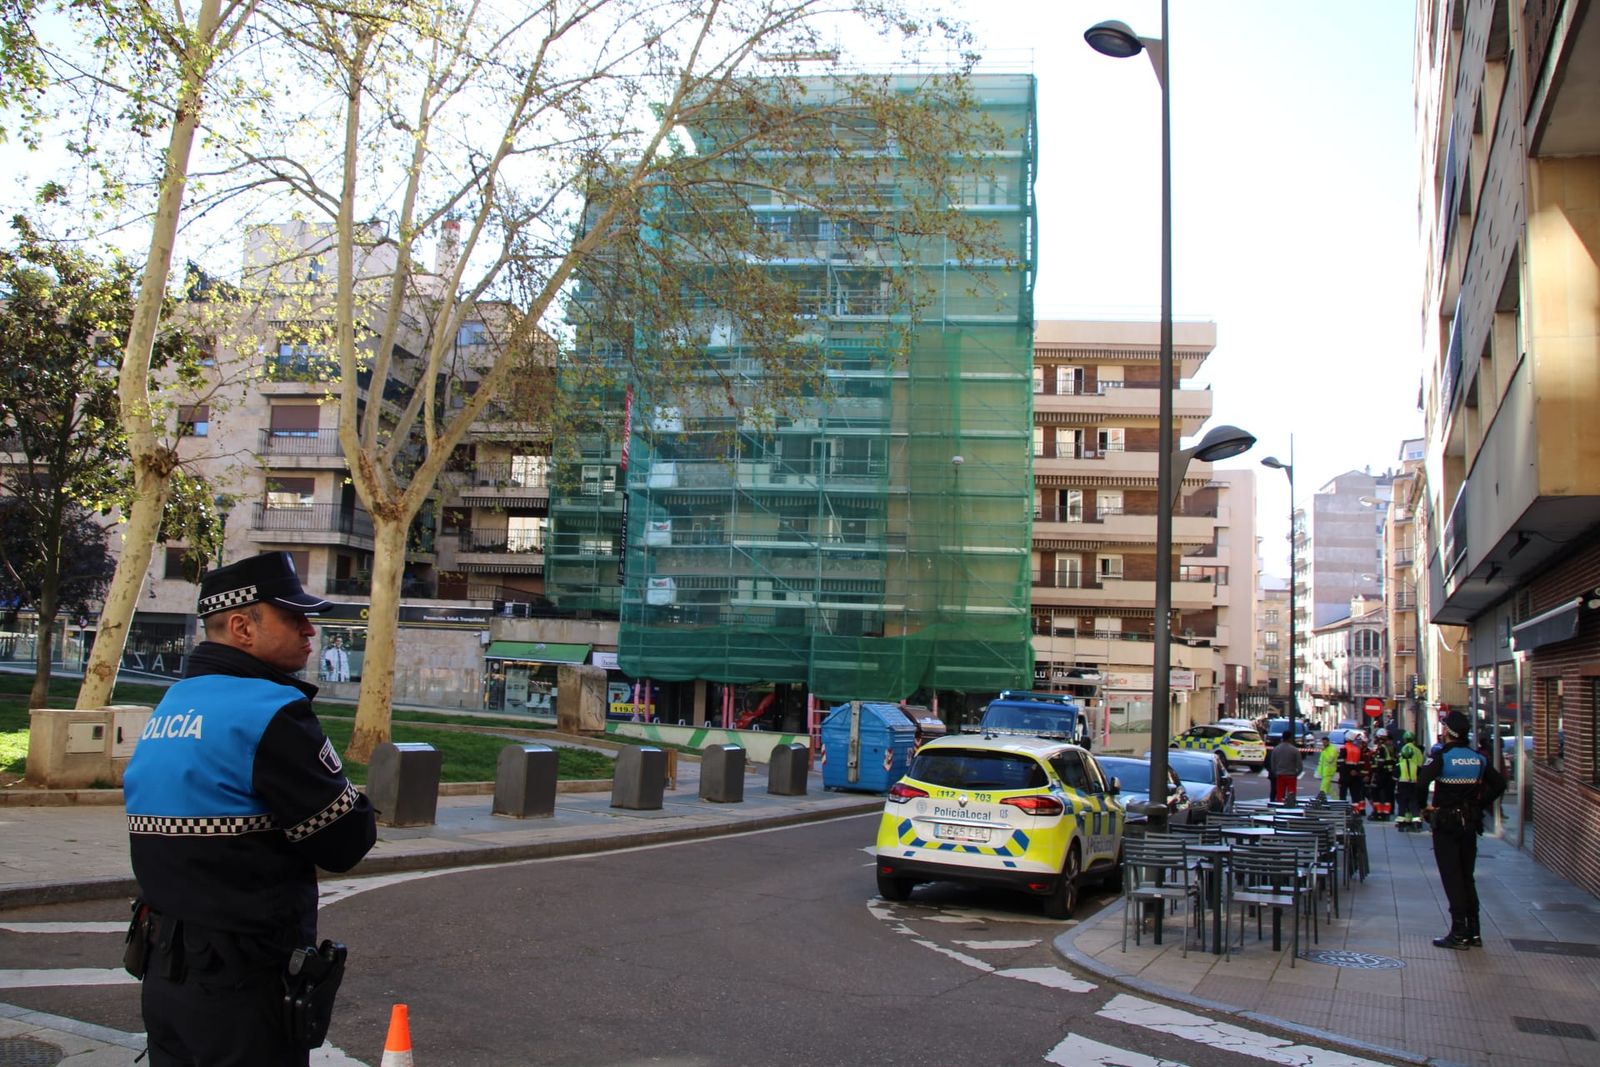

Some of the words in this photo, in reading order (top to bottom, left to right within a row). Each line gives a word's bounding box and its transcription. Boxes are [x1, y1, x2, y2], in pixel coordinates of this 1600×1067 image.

[142, 709, 203, 740] OLICÍA
[940, 790, 956, 798] 112
[974, 792, 992, 803] 703
